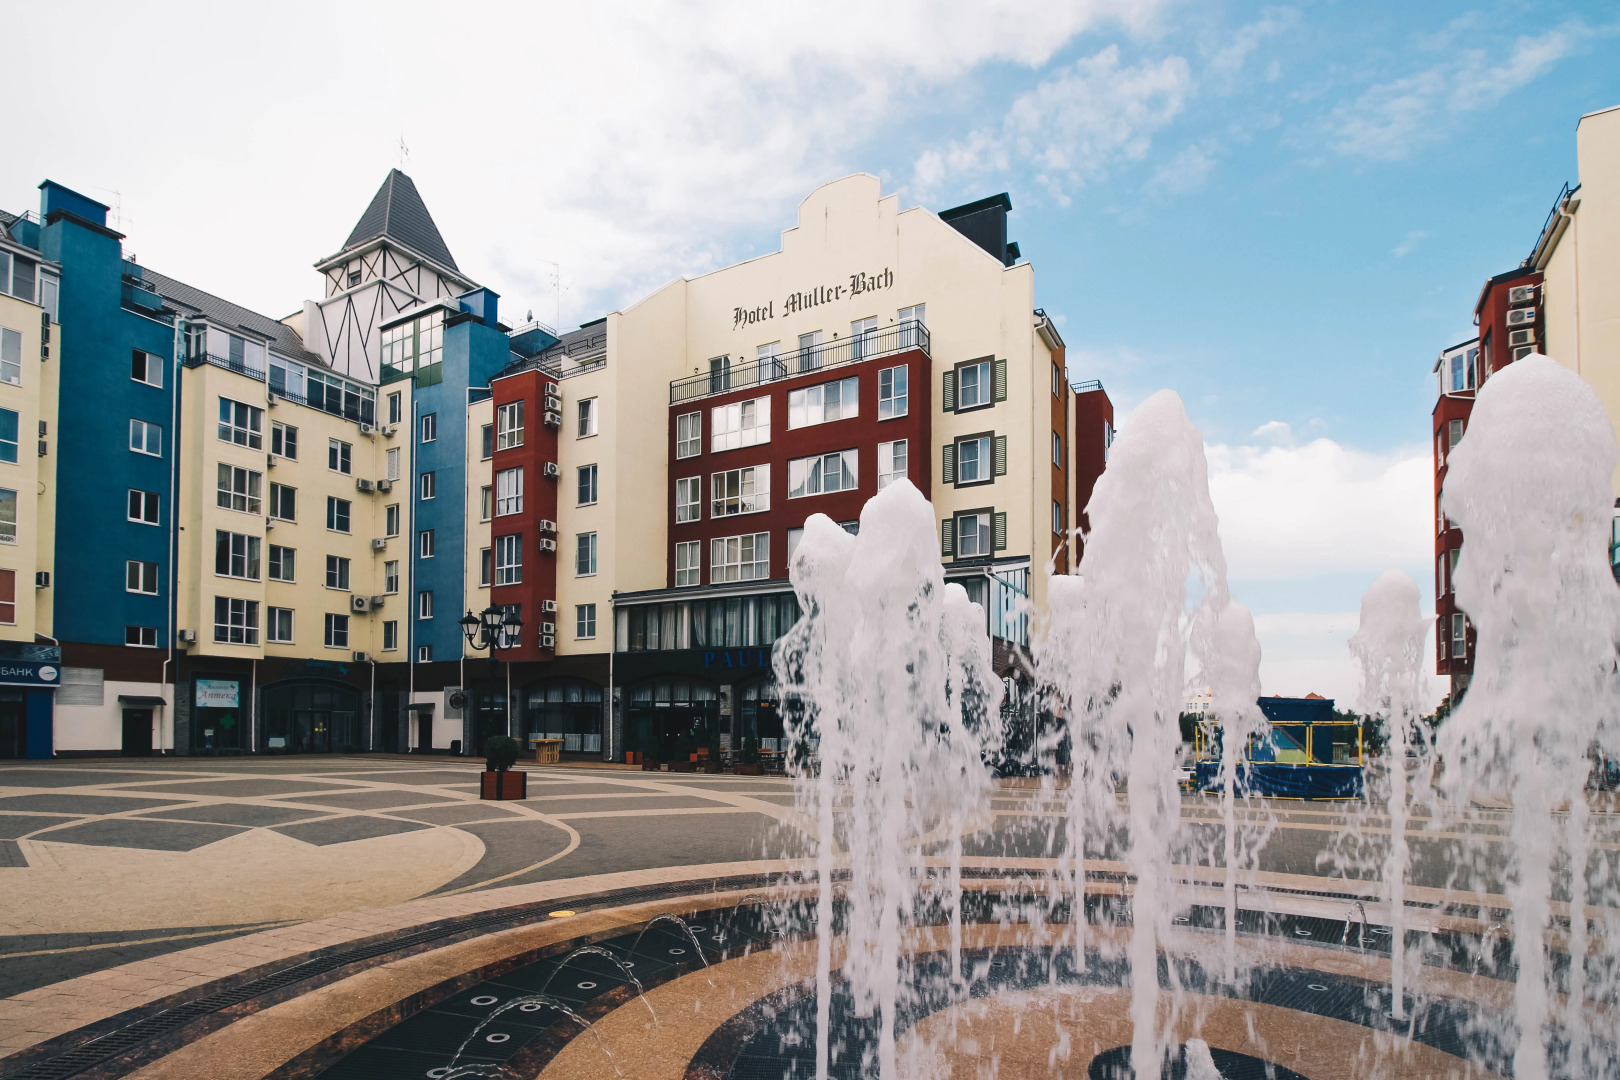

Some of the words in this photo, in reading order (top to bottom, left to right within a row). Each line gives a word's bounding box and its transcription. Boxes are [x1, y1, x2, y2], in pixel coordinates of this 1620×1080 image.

[733, 300, 774, 331] Hotel
[783, 267, 894, 318] Müller-Bach
[1, 666, 34, 677] БАНК
[198, 690, 237, 700] Аптека
